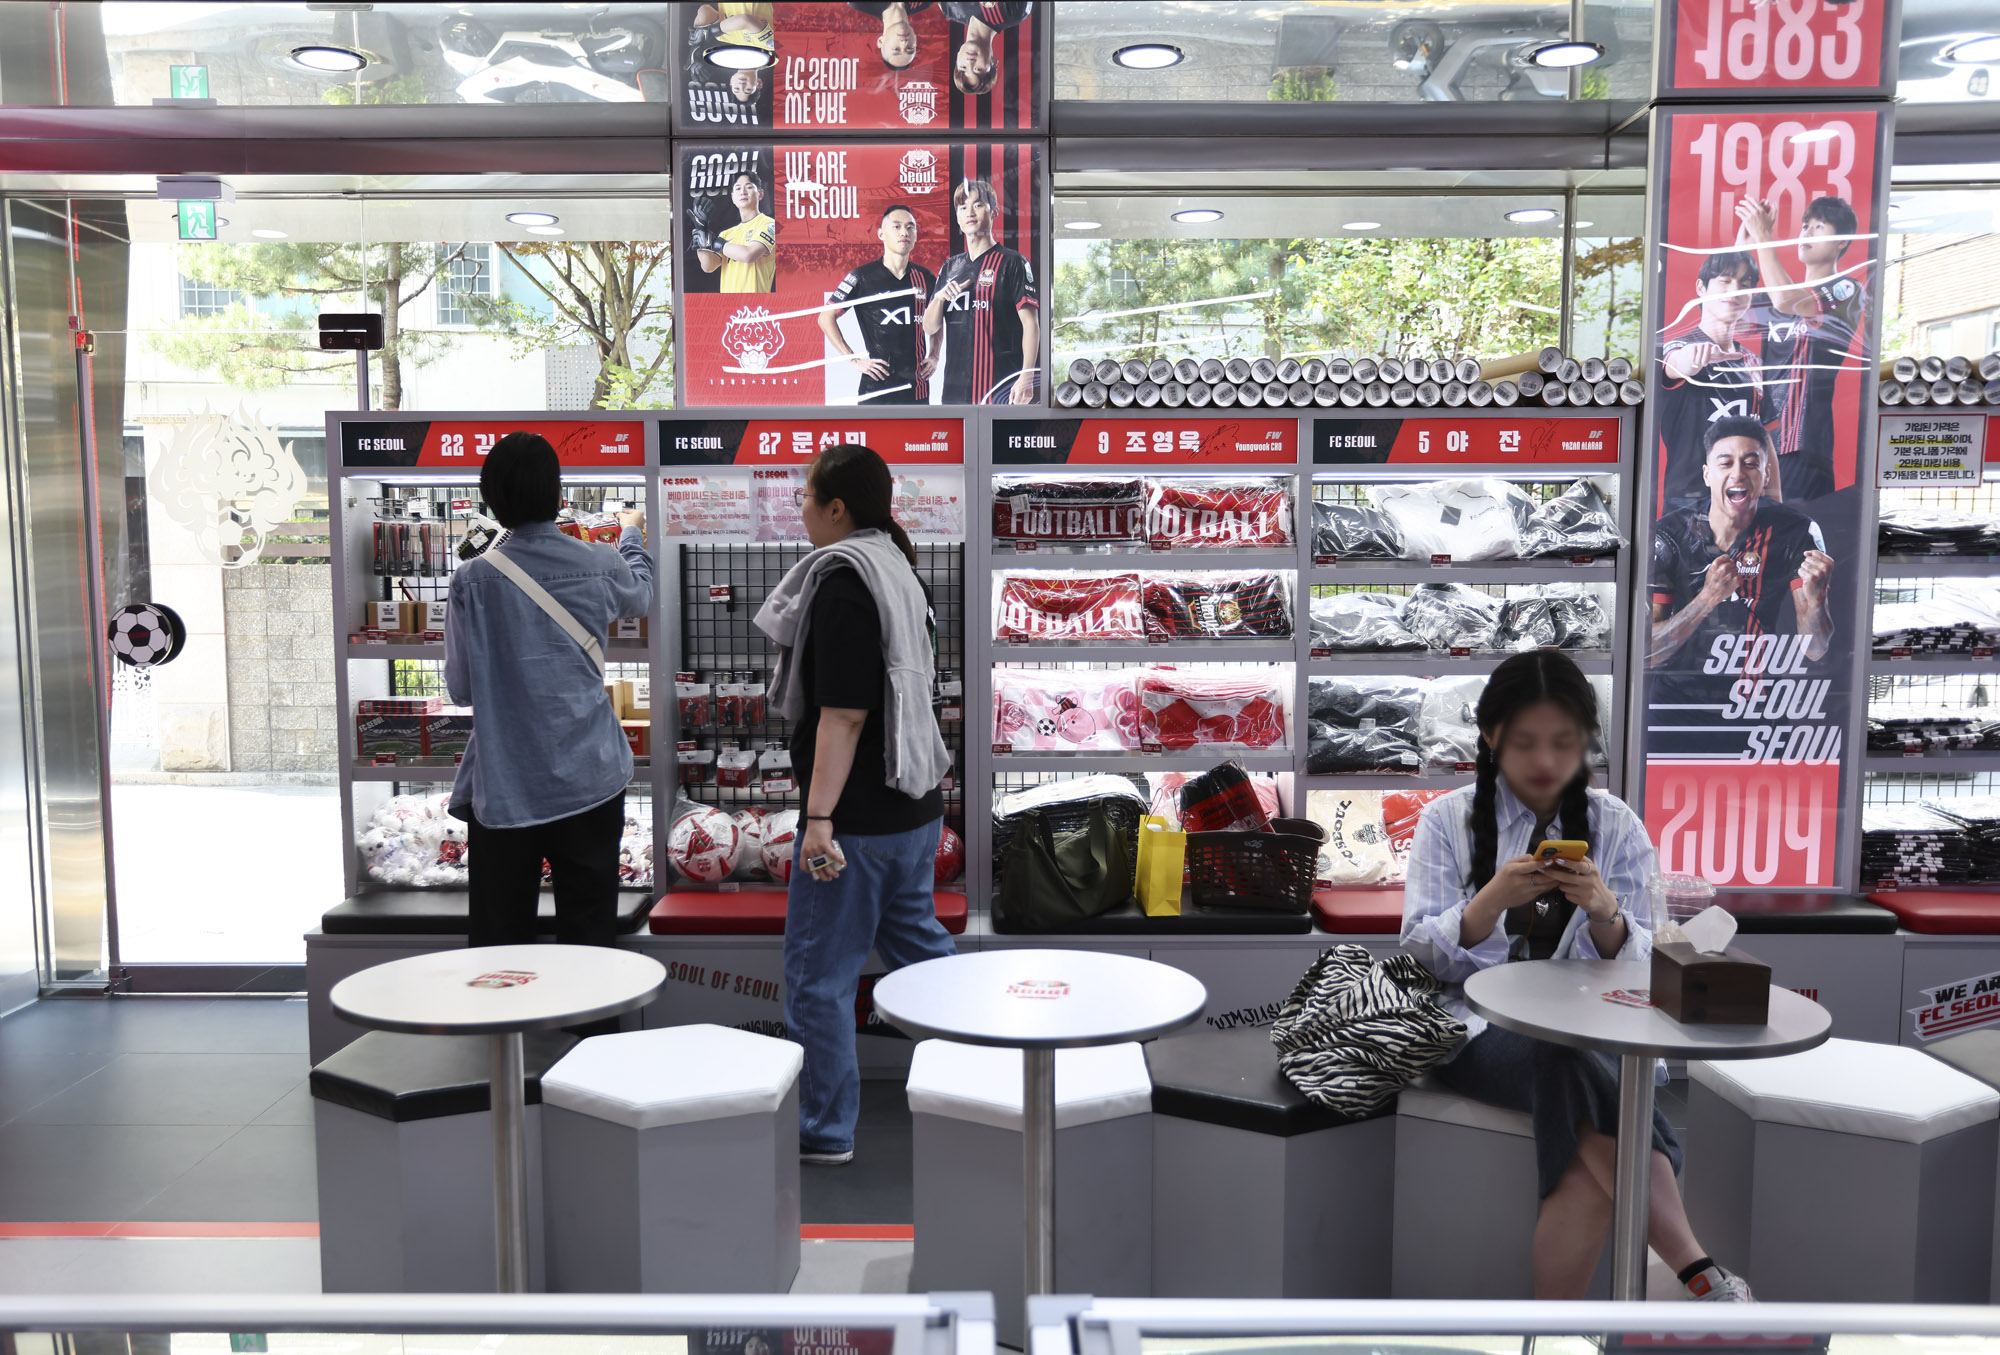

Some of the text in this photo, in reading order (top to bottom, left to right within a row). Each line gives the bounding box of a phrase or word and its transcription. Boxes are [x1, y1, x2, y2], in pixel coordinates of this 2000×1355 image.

[785, 151, 848, 184] WE ARE
[1690, 121, 1856, 242] 1983
[786, 186, 860, 219] FC SEOUL
[1932, 422, 1960, 432] 가격은
[615, 433, 630, 442] DF
[931, 431, 949, 440] FW
[1265, 431, 1282, 440] FW
[1588, 430, 1603, 439] DF
[358, 438, 407, 451] FC SEOUL
[441, 433, 465, 457] 22
[675, 437, 724, 450] FC SEOUL
[759, 432, 782, 455] 27
[905, 442, 949, 452] Seonmin MOON
[1008, 436, 1057, 449] FC SEOUL
[1098, 431, 1110, 454] 9
[1235, 442, 1282, 453] Youngwook CHO
[1329, 435, 1377, 448] FC SEOUL
[1418, 431, 1430, 454] 5
[1562, 441, 1603, 451] YAZAN ALARAB
[600, 444, 630, 454] Jinsu KIM
[1893, 446, 1911, 456] 기본
[1913, 446, 1939, 456] 유니폼
[1923, 458, 1941, 468] 마킹
[1943, 458, 1961, 468] 비용
[753, 470, 789, 479] FC SEOUL
[1919, 470, 1937, 480] 안내
[1010, 508, 1122, 536] FOOTBALL
[1703, 634, 1813, 675] SEOUL
[1721, 679, 1832, 720] SEOUL
[1742, 725, 1842, 766] SEOUL
[1659, 773, 1824, 885] 2004
[668, 961, 780, 1001] SOUL OF SEOUL
[1934, 975, 2000, 1004] WE AR
[1919, 1005, 1947, 1025] FC
